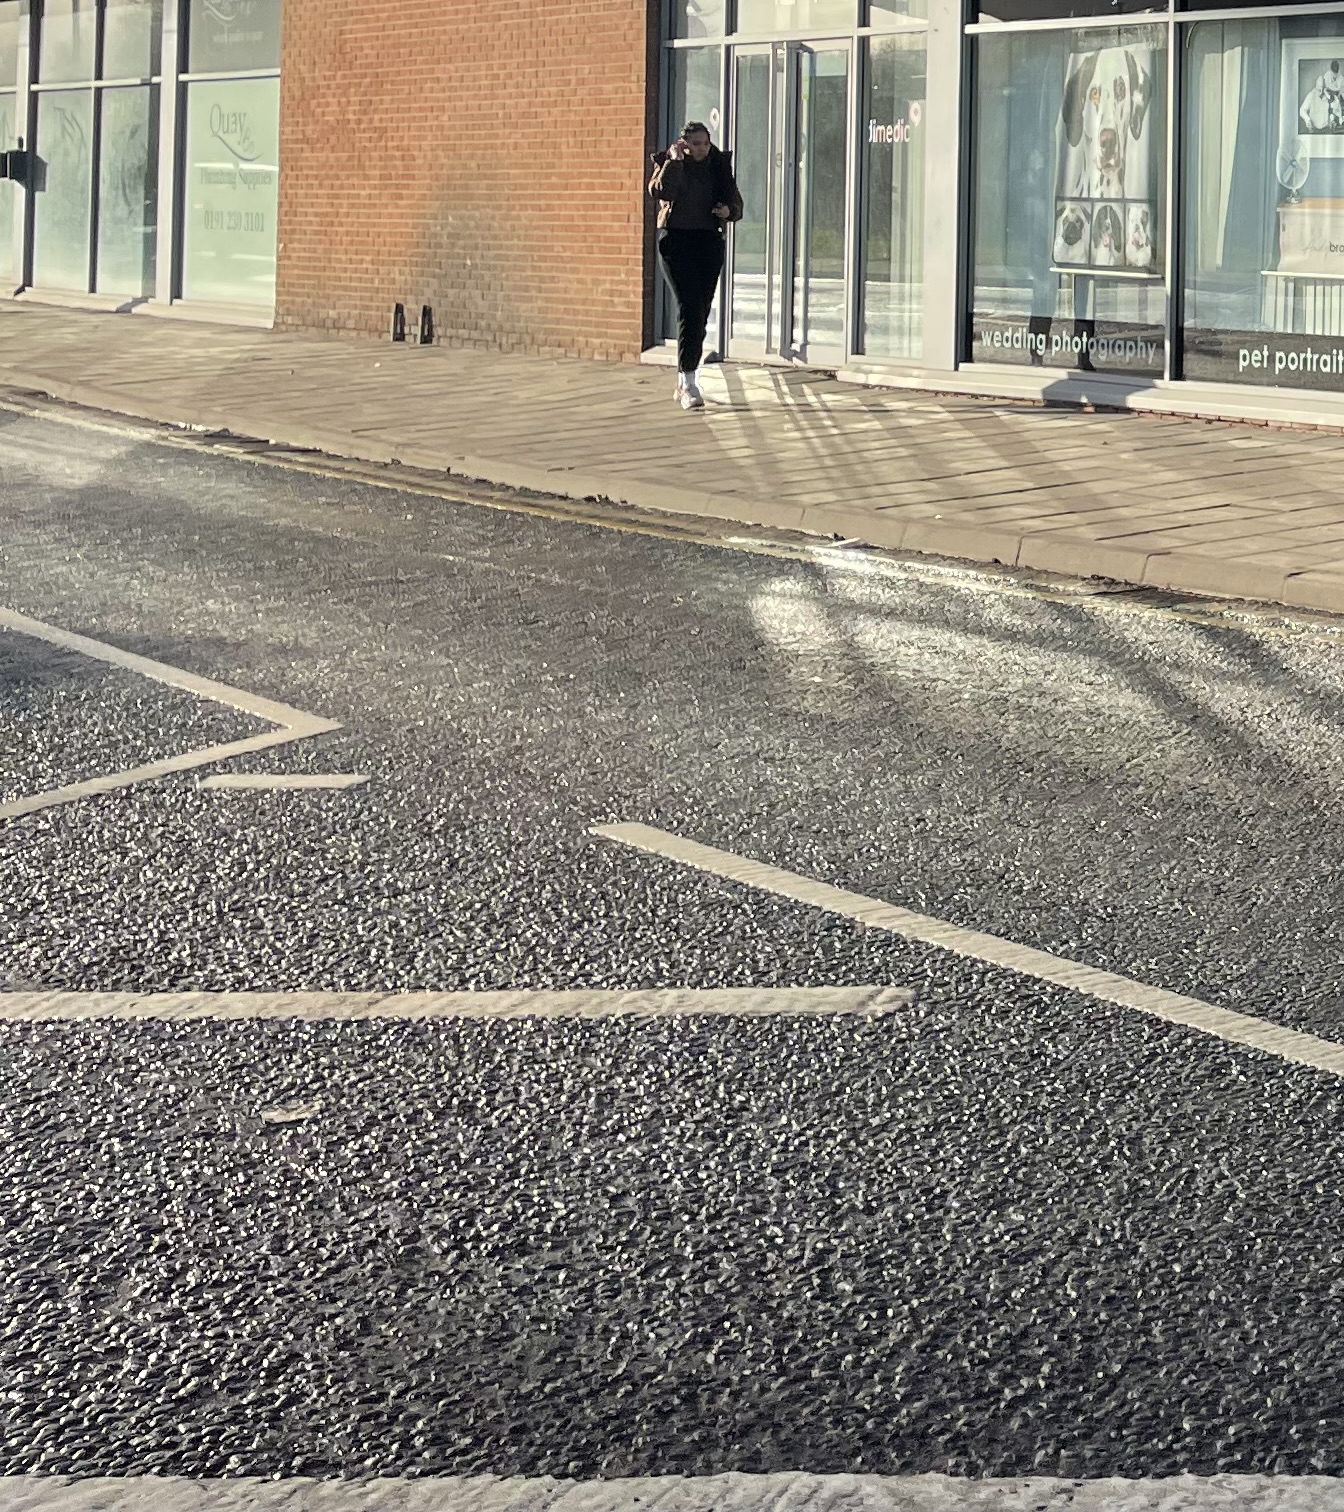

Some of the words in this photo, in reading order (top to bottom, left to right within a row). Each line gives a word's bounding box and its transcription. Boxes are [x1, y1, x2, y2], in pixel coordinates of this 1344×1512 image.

[210, 103, 250, 148] Quay
[204, 209, 224, 231] 0191
[981, 326, 1046, 356] wedding
[1051, 331, 1157, 365] photography
[1239, 343, 1269, 372] pet
